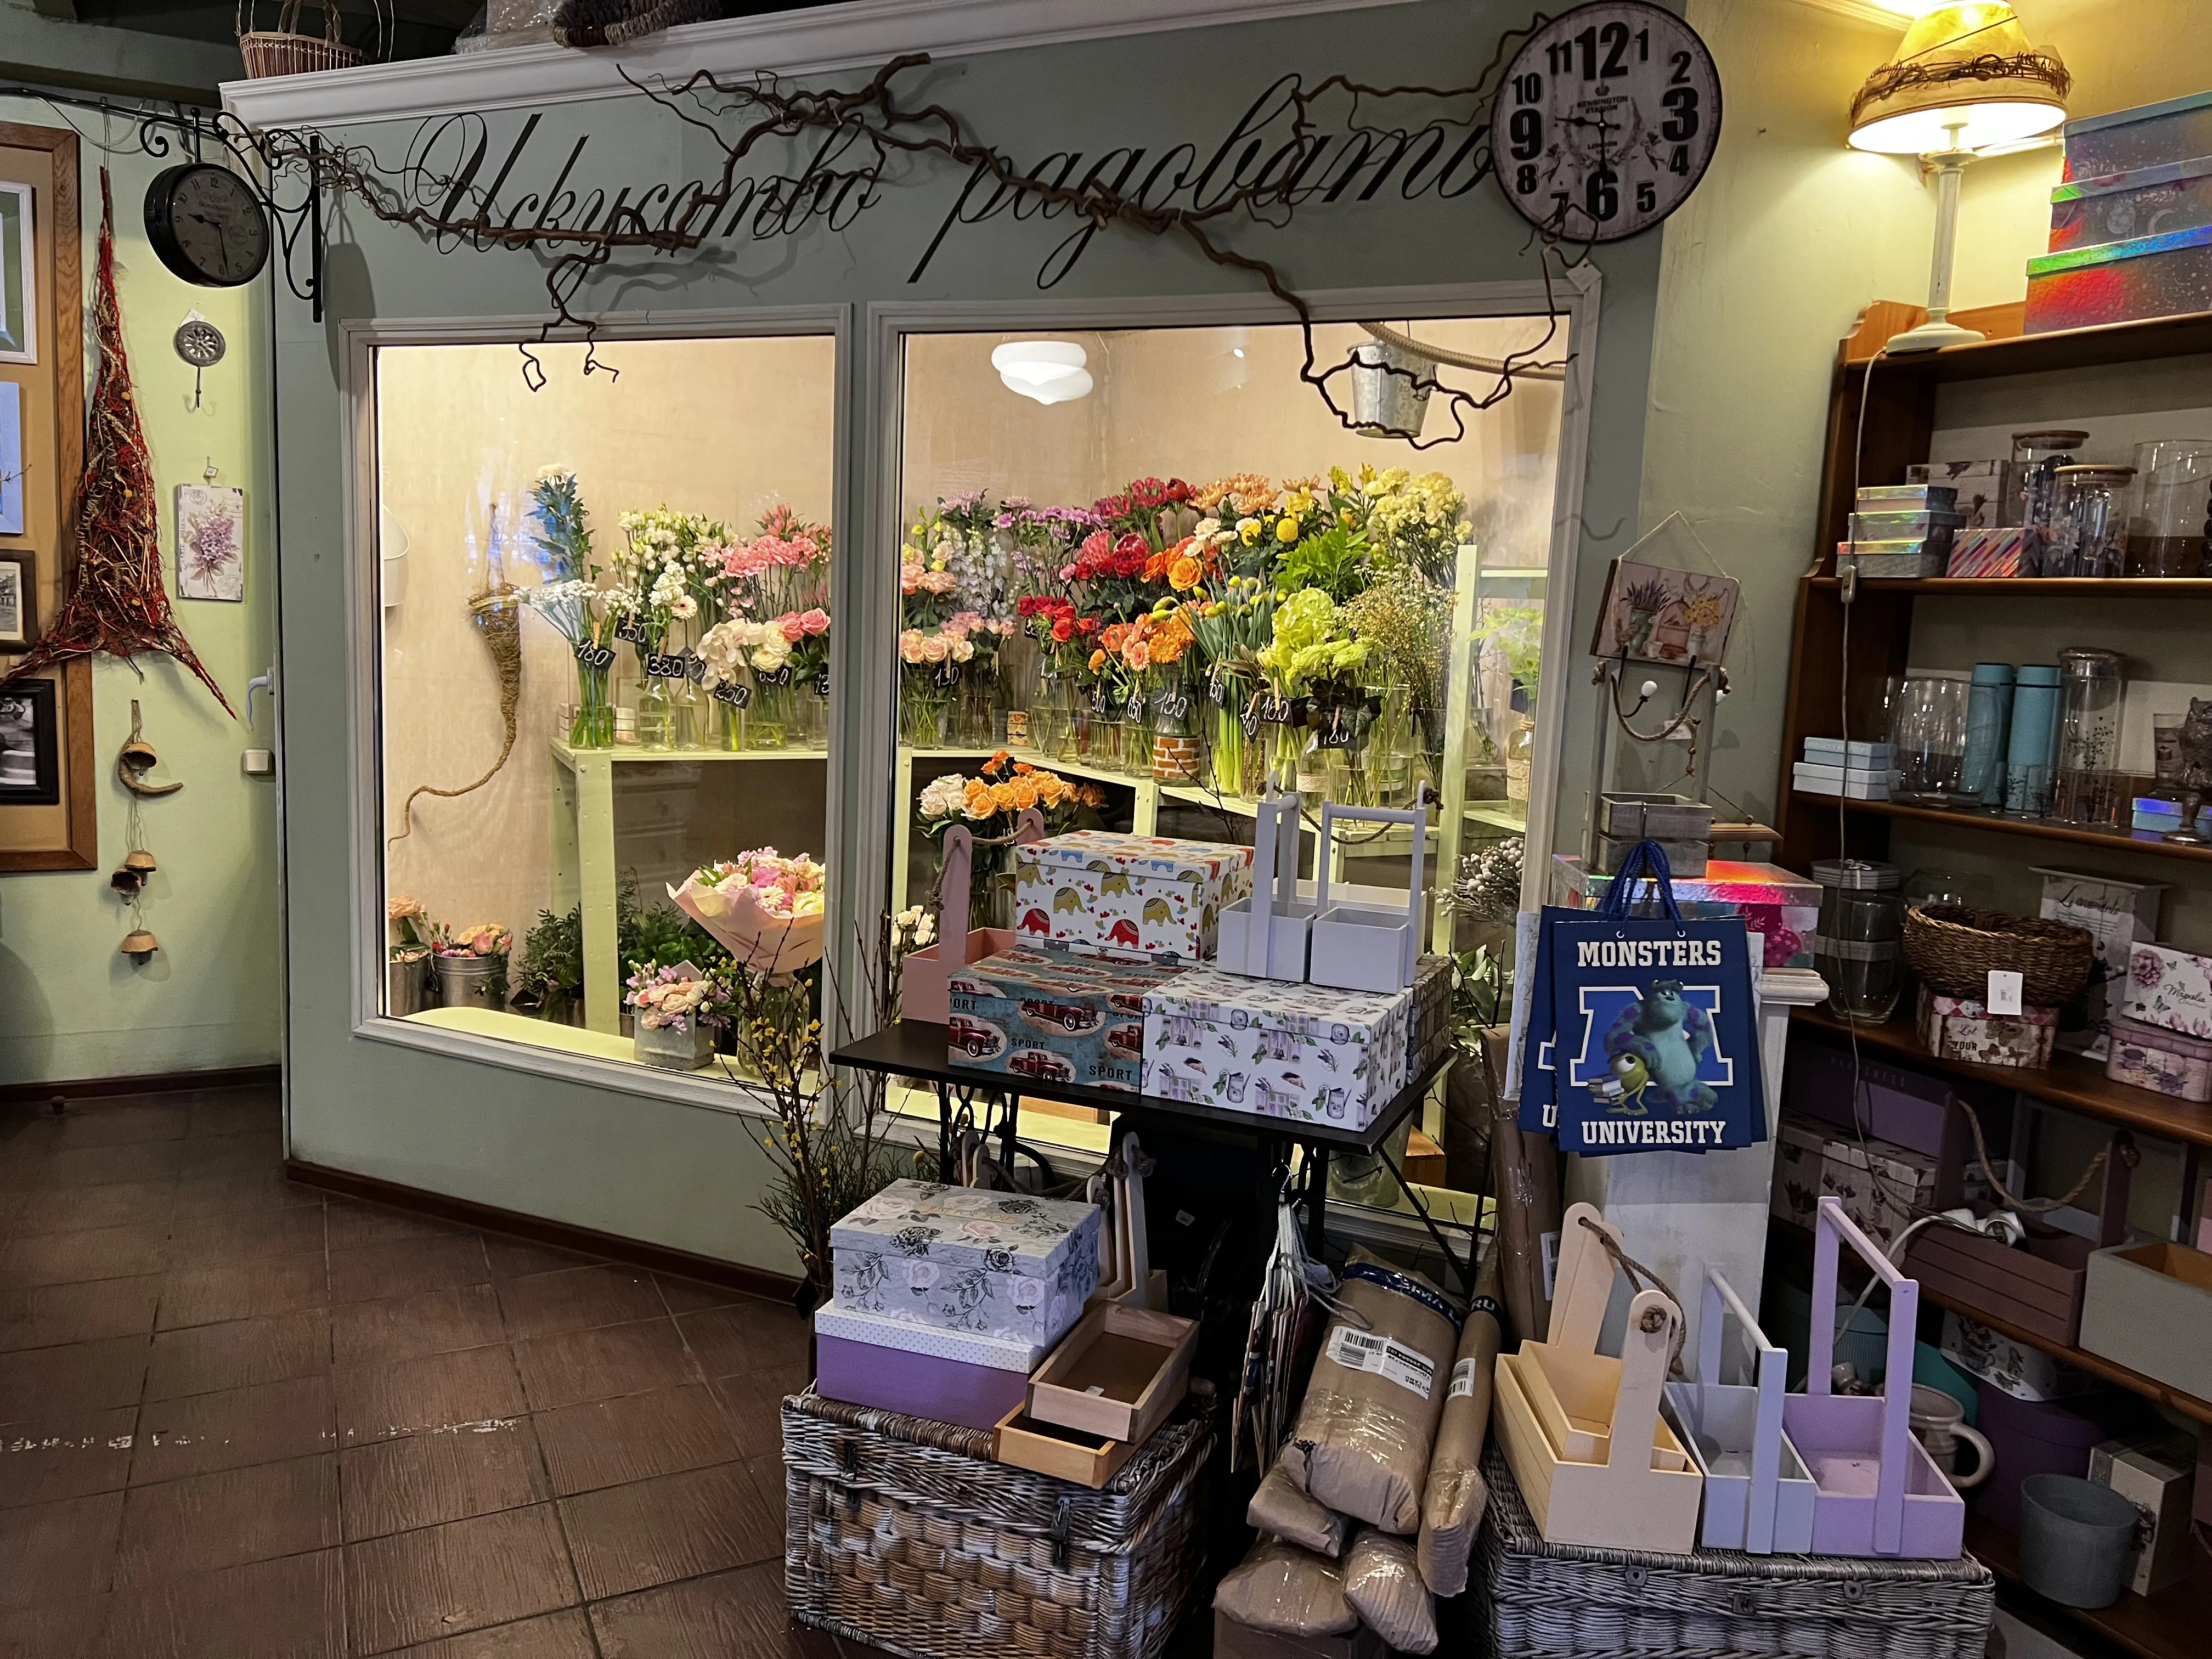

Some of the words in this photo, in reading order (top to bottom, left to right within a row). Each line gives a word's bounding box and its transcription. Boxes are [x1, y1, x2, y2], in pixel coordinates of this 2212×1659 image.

[1545, 40, 1572, 74] 11
[1575, 21, 1629, 81] 12
[1636, 29, 1649, 61] 1
[1671, 51, 1691, 84] 2
[1512, 72, 1542, 105] 10
[1662, 87, 1699, 142] 3
[1510, 109, 1542, 160] 9
[1669, 144, 1689, 176] 4
[191, 179, 201, 190] 11
[210, 177, 218, 188] 12
[1516, 164, 1538, 194] 8
[1586, 169, 1618, 221] 6
[1637, 182, 1656, 213] 5
[578, 640, 609, 665] 180
[648, 656, 684, 676] 380
[1154, 692, 1187, 718] 150
[1577, 940, 1722, 967] MONSTERS
[1011, 1038, 1045, 1050] SPORT
[1088, 1065, 1133, 1081] SPORT
[1581, 1121, 1726, 1144] UNIVERSITY
[928, 1206, 952, 1215] JUST
[953, 1209, 979, 1218] FOR
[982, 1212, 1012, 1222] YOU
